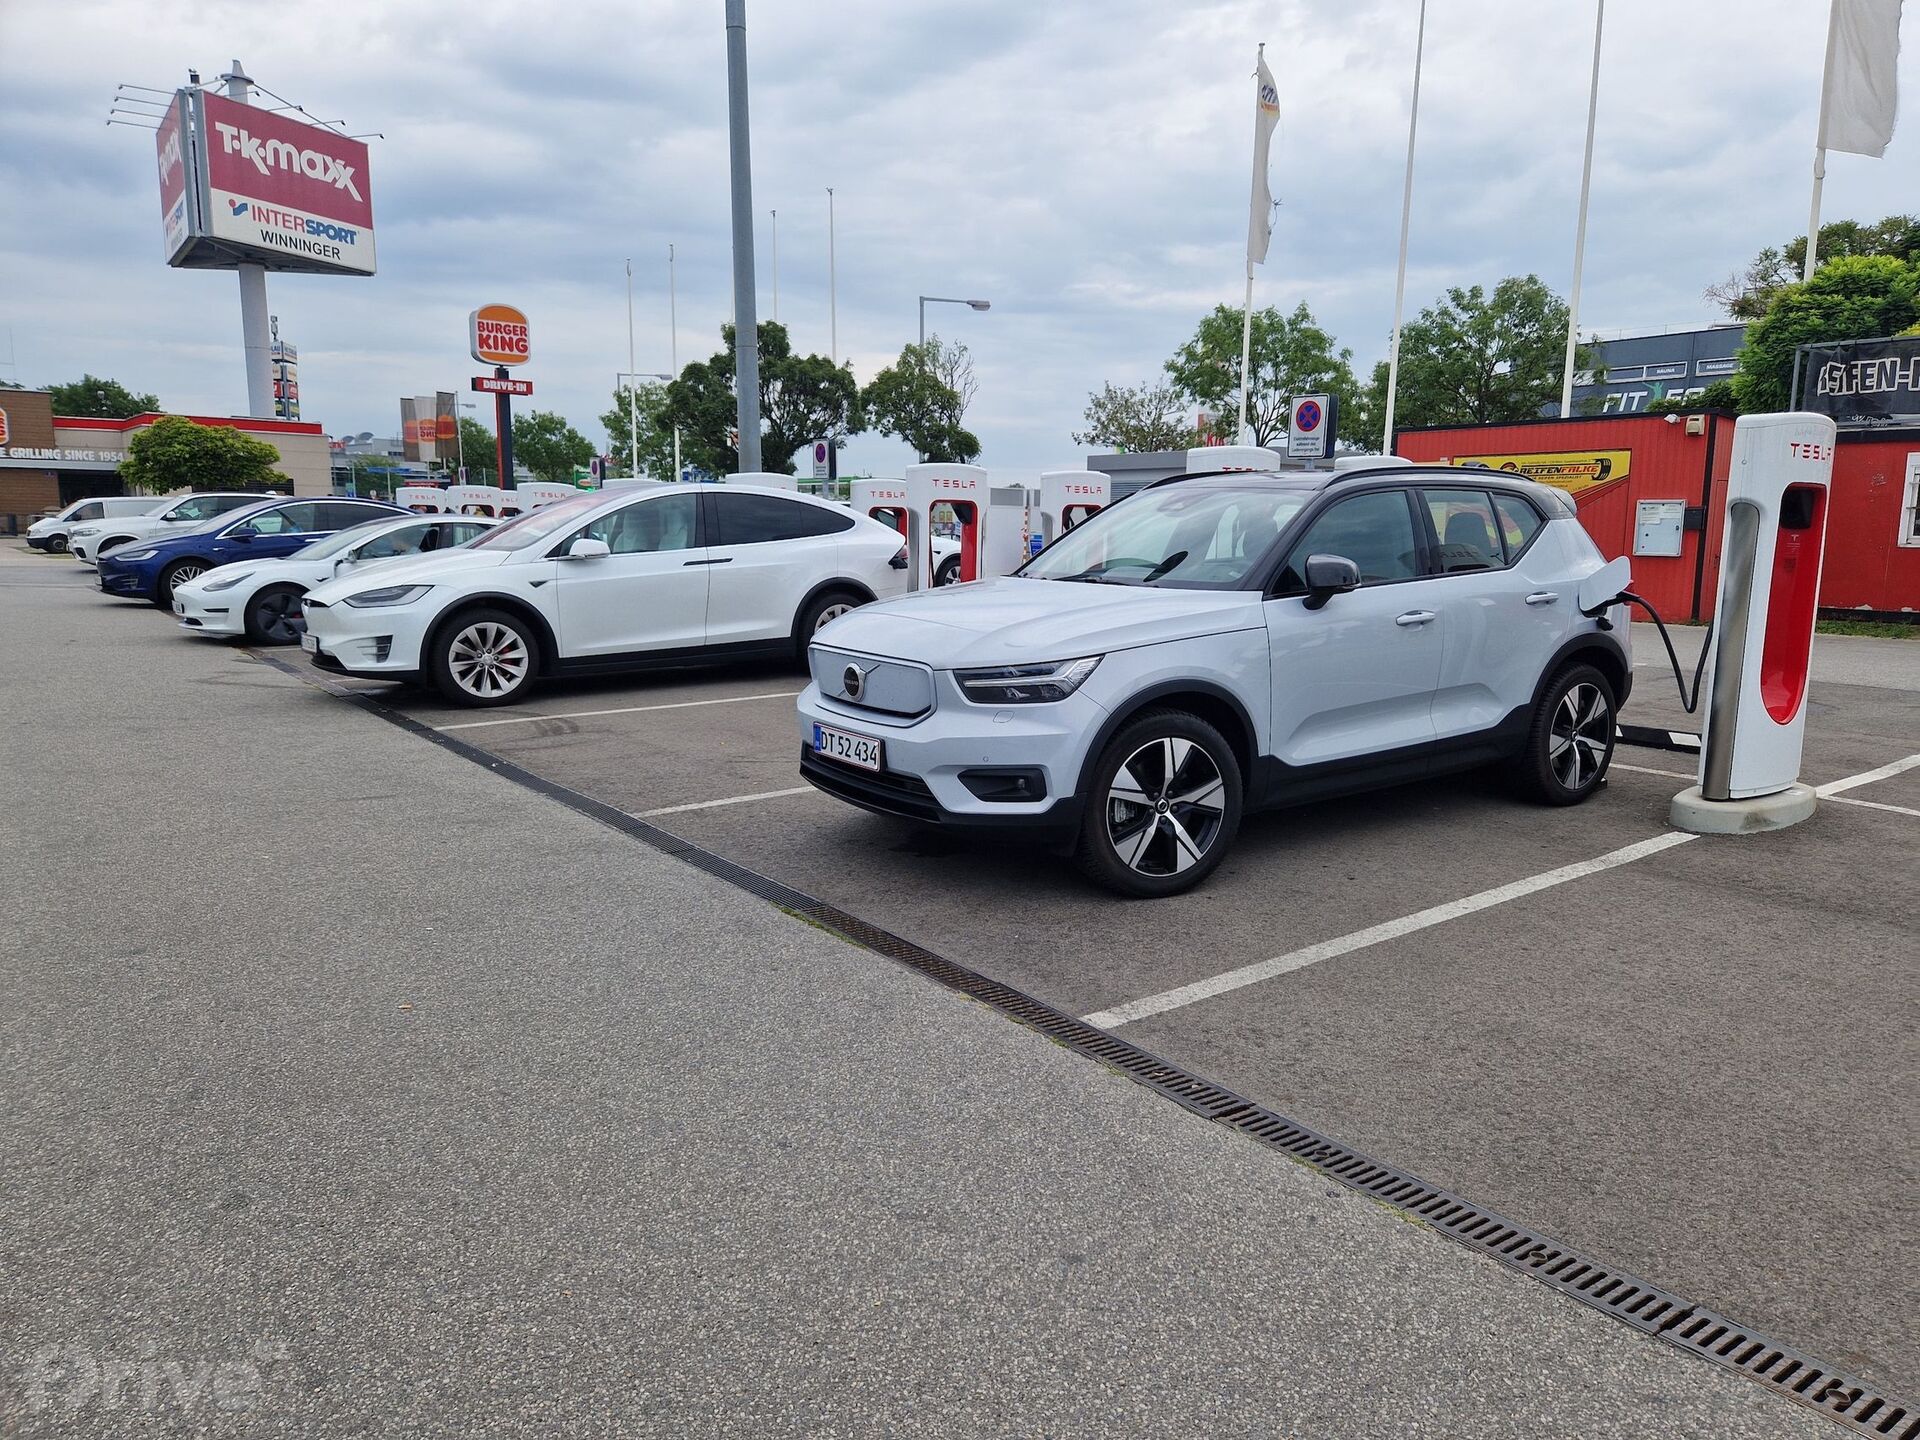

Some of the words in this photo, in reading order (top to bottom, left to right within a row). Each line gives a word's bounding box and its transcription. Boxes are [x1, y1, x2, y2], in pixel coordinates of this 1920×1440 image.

[252, 204, 357, 245] INTERSPORT
[260, 229, 341, 260] WINNINGER
[477, 320, 528, 337] BURGER
[477, 333, 528, 353] KING
[483, 380, 527, 392] DRIVE-IN
[1602, 391, 1648, 413] FIT
[9, 447, 61, 460] GRILLING
[65, 450, 95, 461] SINCE
[99, 451, 124, 462] 1954
[932, 479, 976, 488] TESLA
[1065, 485, 1102, 494] TESLA
[532, 491, 567, 499] TESLA
[870, 490, 906, 498] TESLA
[821, 731, 835, 752] DT
[838, 736, 852, 758] 52
[854, 740, 877, 765] 434
